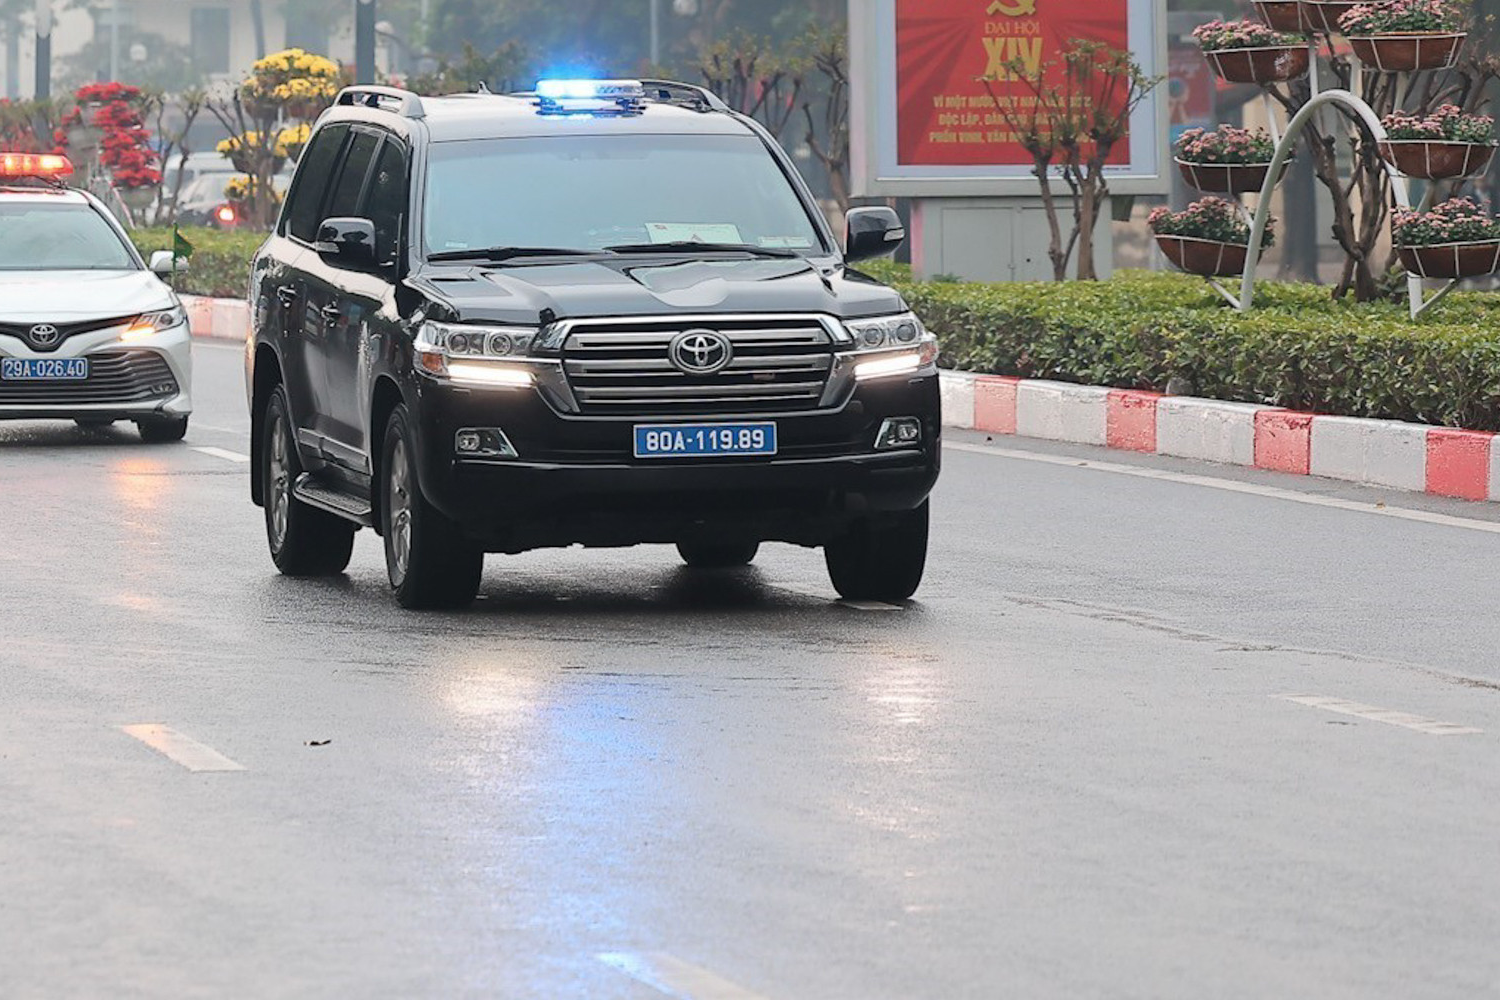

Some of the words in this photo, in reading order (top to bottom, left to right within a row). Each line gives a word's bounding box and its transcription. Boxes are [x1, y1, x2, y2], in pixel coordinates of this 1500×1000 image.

[984, 22, 1010, 37] ĐẠI
[1014, 20, 1040, 37] HỘI
[981, 37, 1043, 81] XIV
[4, 360, 85, 378] 29A-026.40
[646, 429, 765, 452] 80A-119.89
